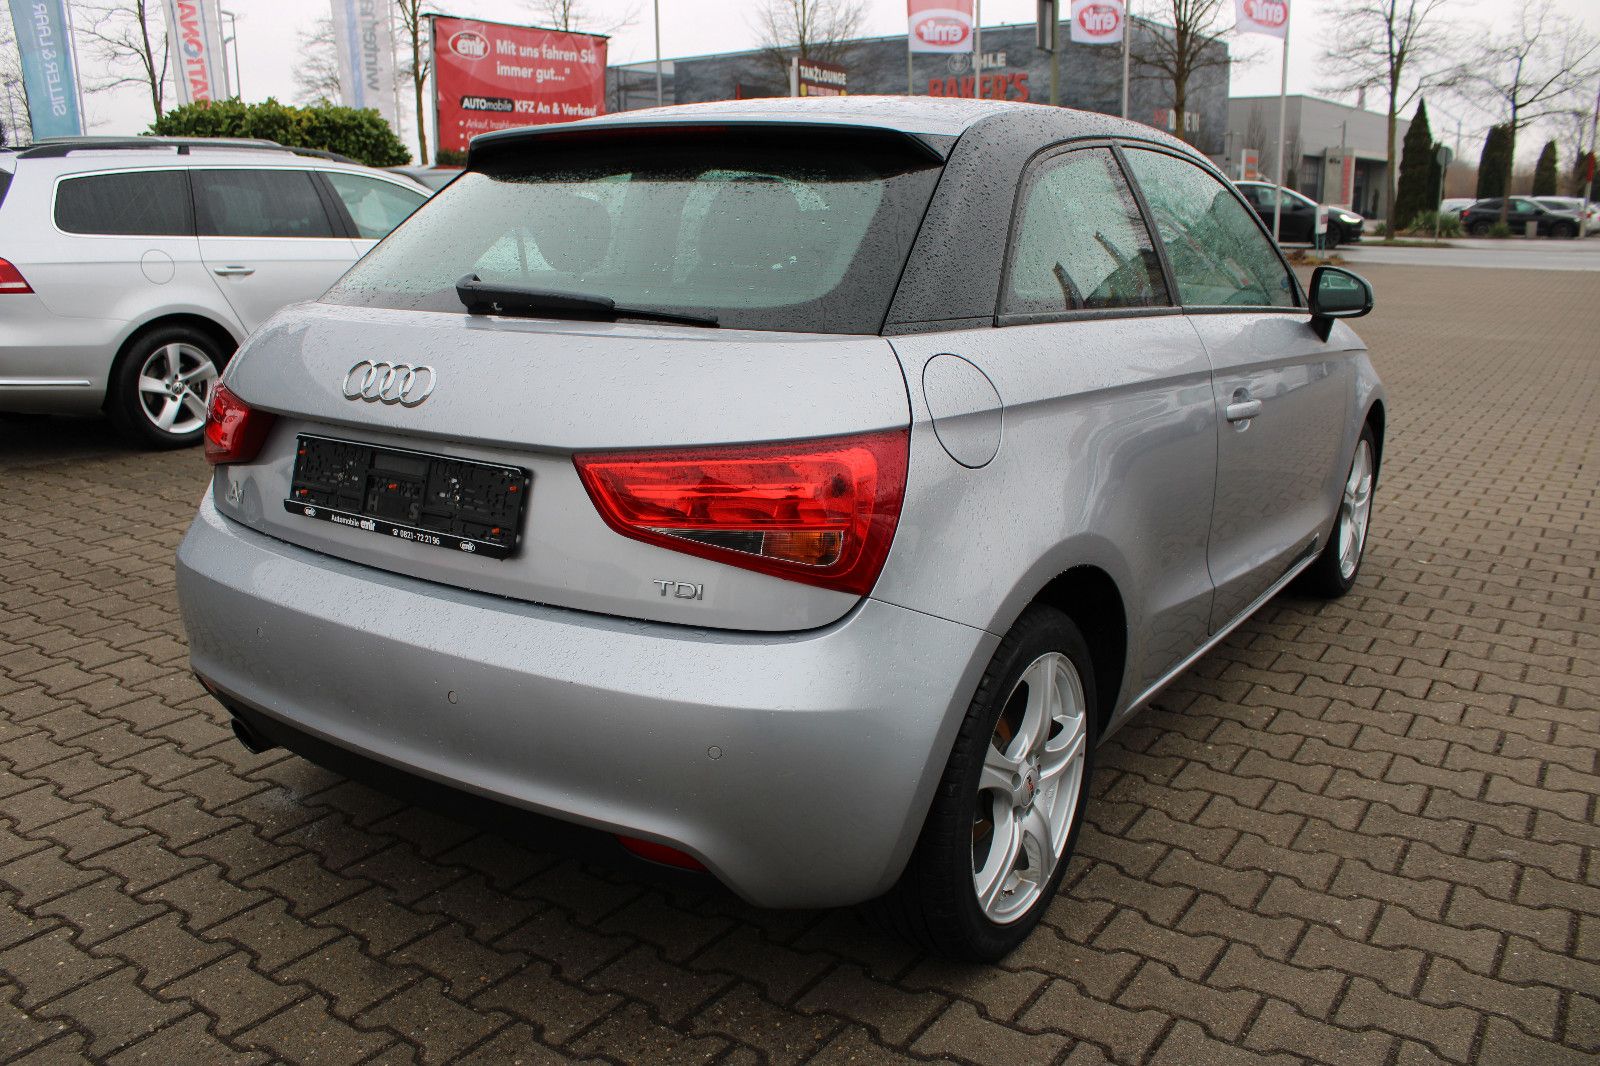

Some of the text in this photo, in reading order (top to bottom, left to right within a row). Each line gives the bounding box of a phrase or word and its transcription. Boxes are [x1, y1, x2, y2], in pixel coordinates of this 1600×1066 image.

[496, 39, 517, 55] Mit
[519, 44, 539, 58] uns
[542, 44, 577, 62] fahren
[496, 60, 533, 79] immer
[462, 97, 597, 117] AUTOmobile KFZ An & Verkauf
[330, 513, 376, 532] Automobile emir
[653, 579, 704, 601] TDI
